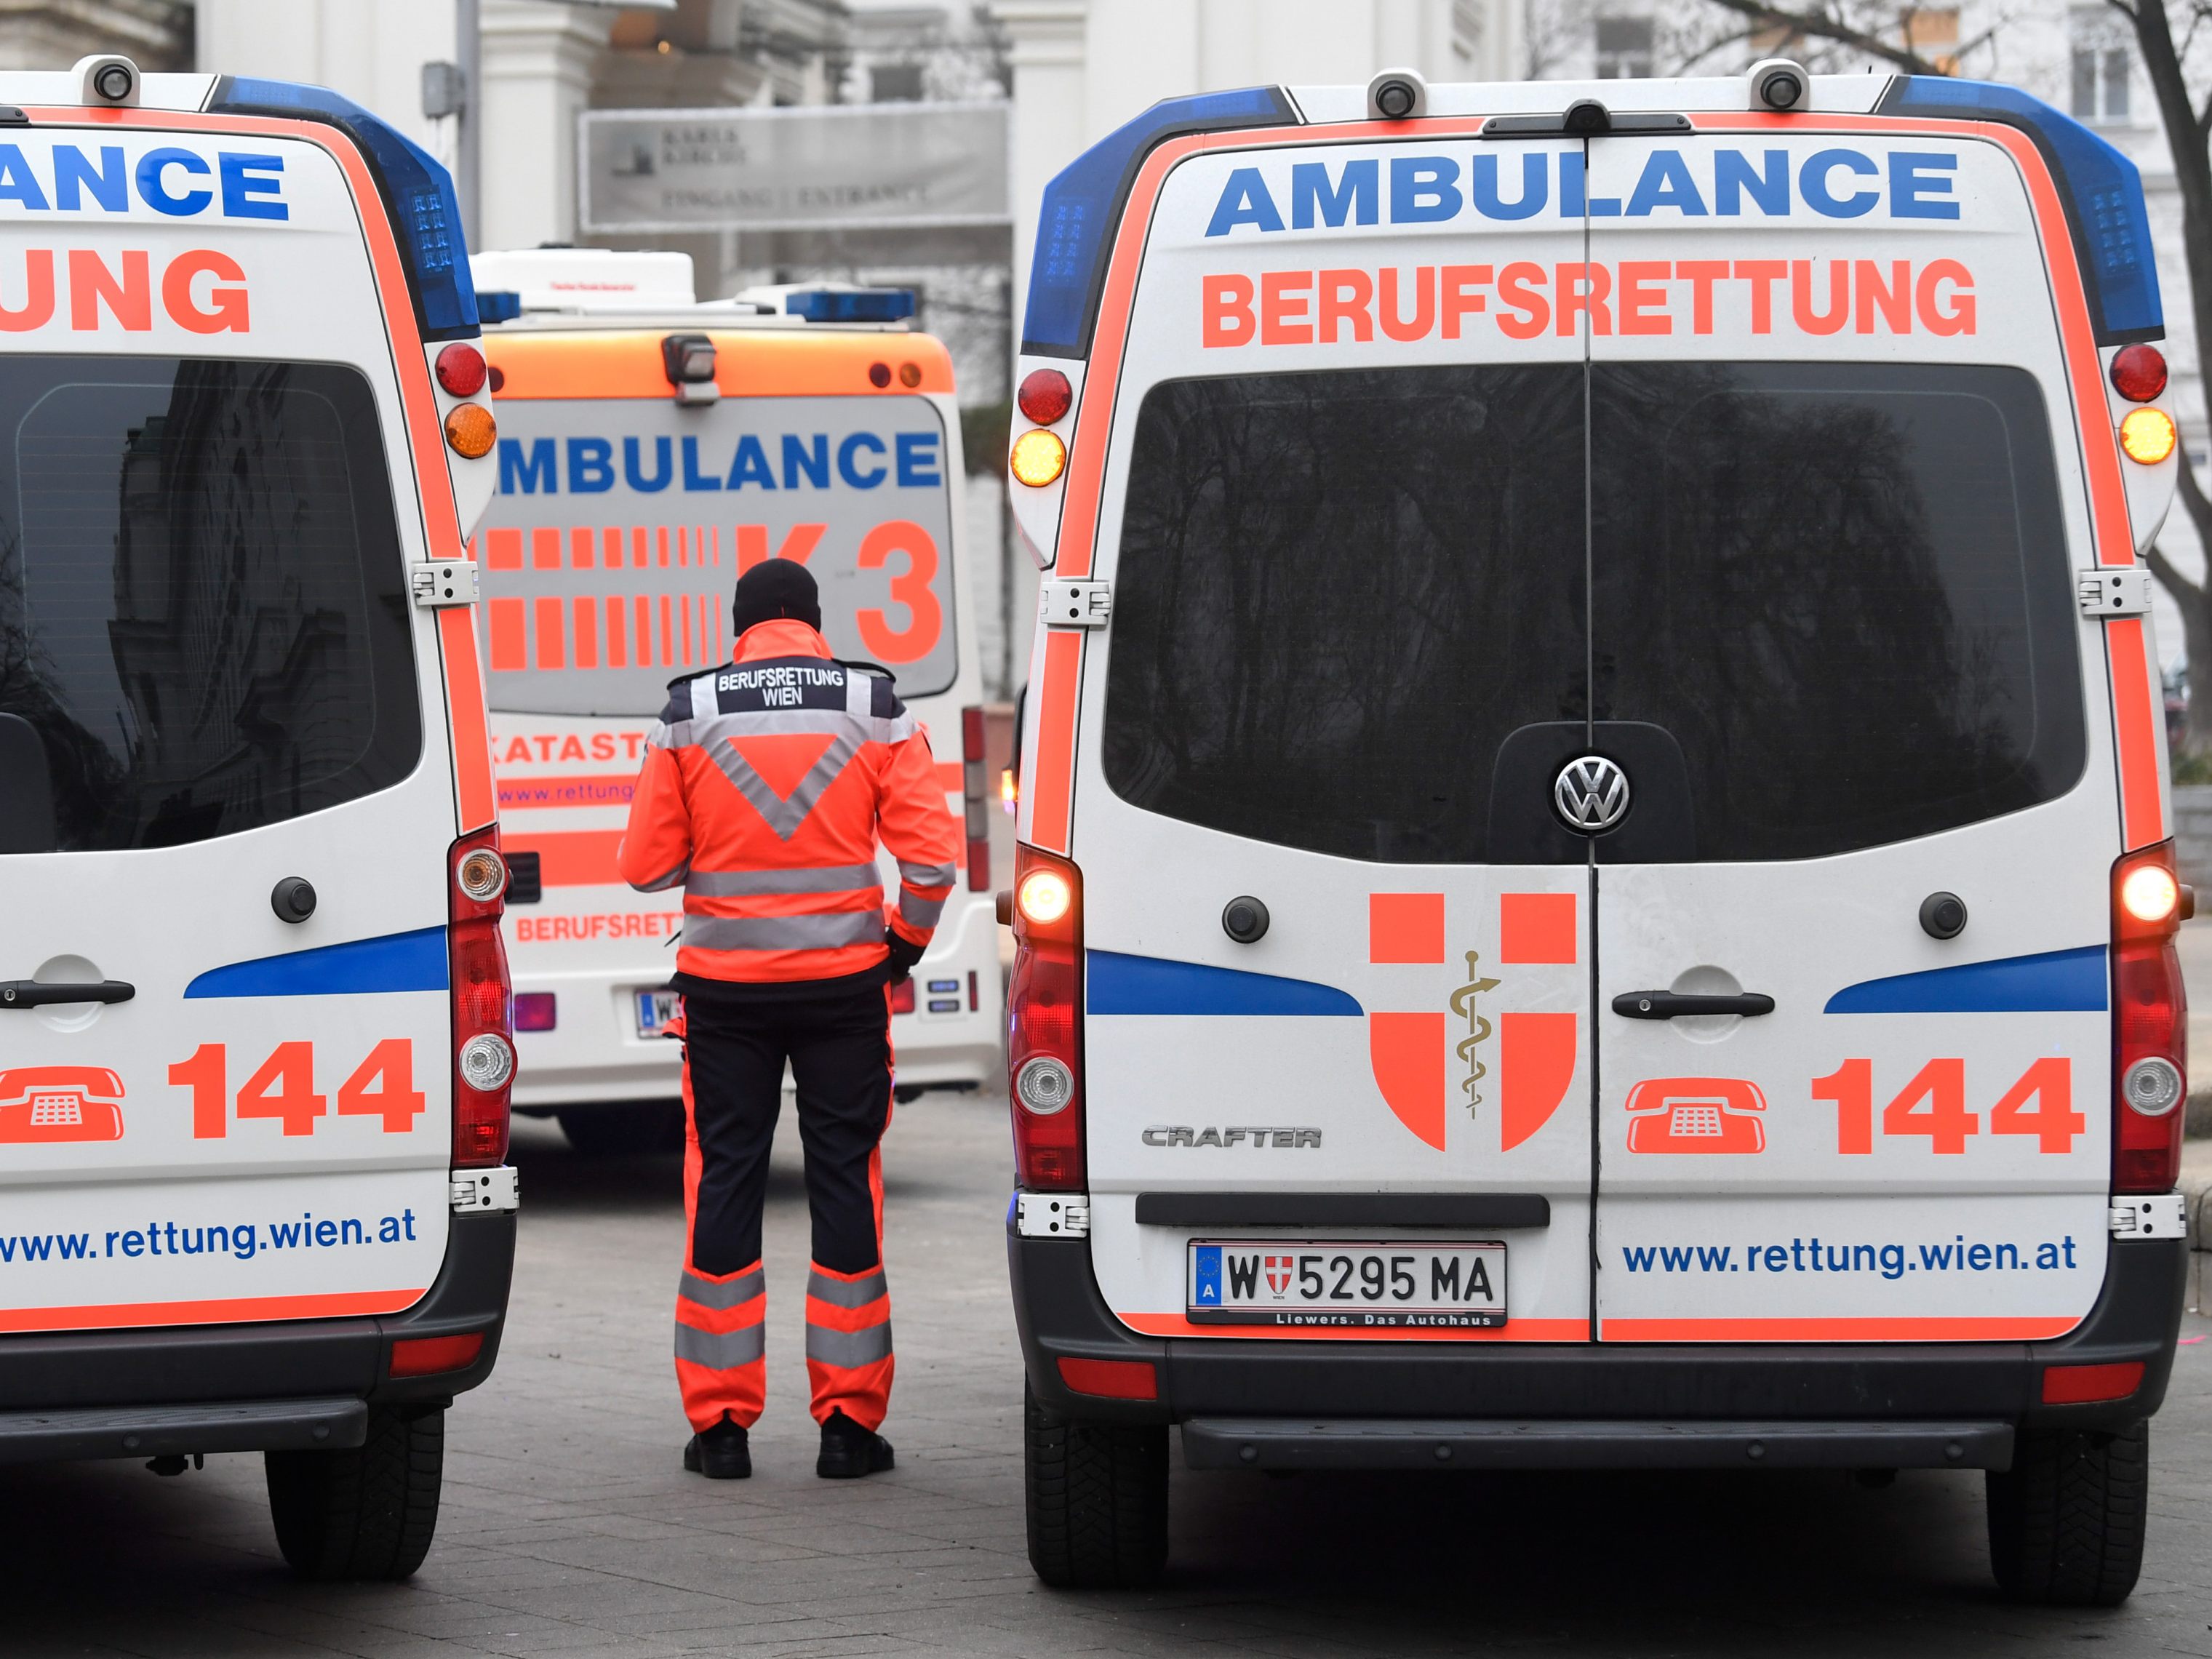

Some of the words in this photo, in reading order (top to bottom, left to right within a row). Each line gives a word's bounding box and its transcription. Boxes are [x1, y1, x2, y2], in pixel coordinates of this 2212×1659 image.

[1205, 148, 1960, 237] AMBULANCE
[1202, 258, 1976, 348] BERUFSRETTUNG
[492, 432, 942, 495] MBULANCE
[855, 519, 943, 664] 3
[719, 666, 844, 692] BERUFSRETTUNG
[762, 687, 802, 706] WIEN
[168, 1038, 426, 1139] 144
[1811, 1058, 2085, 1155] 144
[1142, 1125, 1322, 1148] CRAFTER
[1228, 1255, 1260, 1300] W
[1299, 1255, 1416, 1300] 5295
[1432, 1256, 1493, 1301] MA
[1623, 1235, 2077, 1280] www.rettung.wien.at
[1202, 1284, 1215, 1298] A
[1276, 1313, 1355, 1324] Liewers.
[1365, 1314, 1396, 1324] Das
[1406, 1315, 1491, 1326] Autohaus
